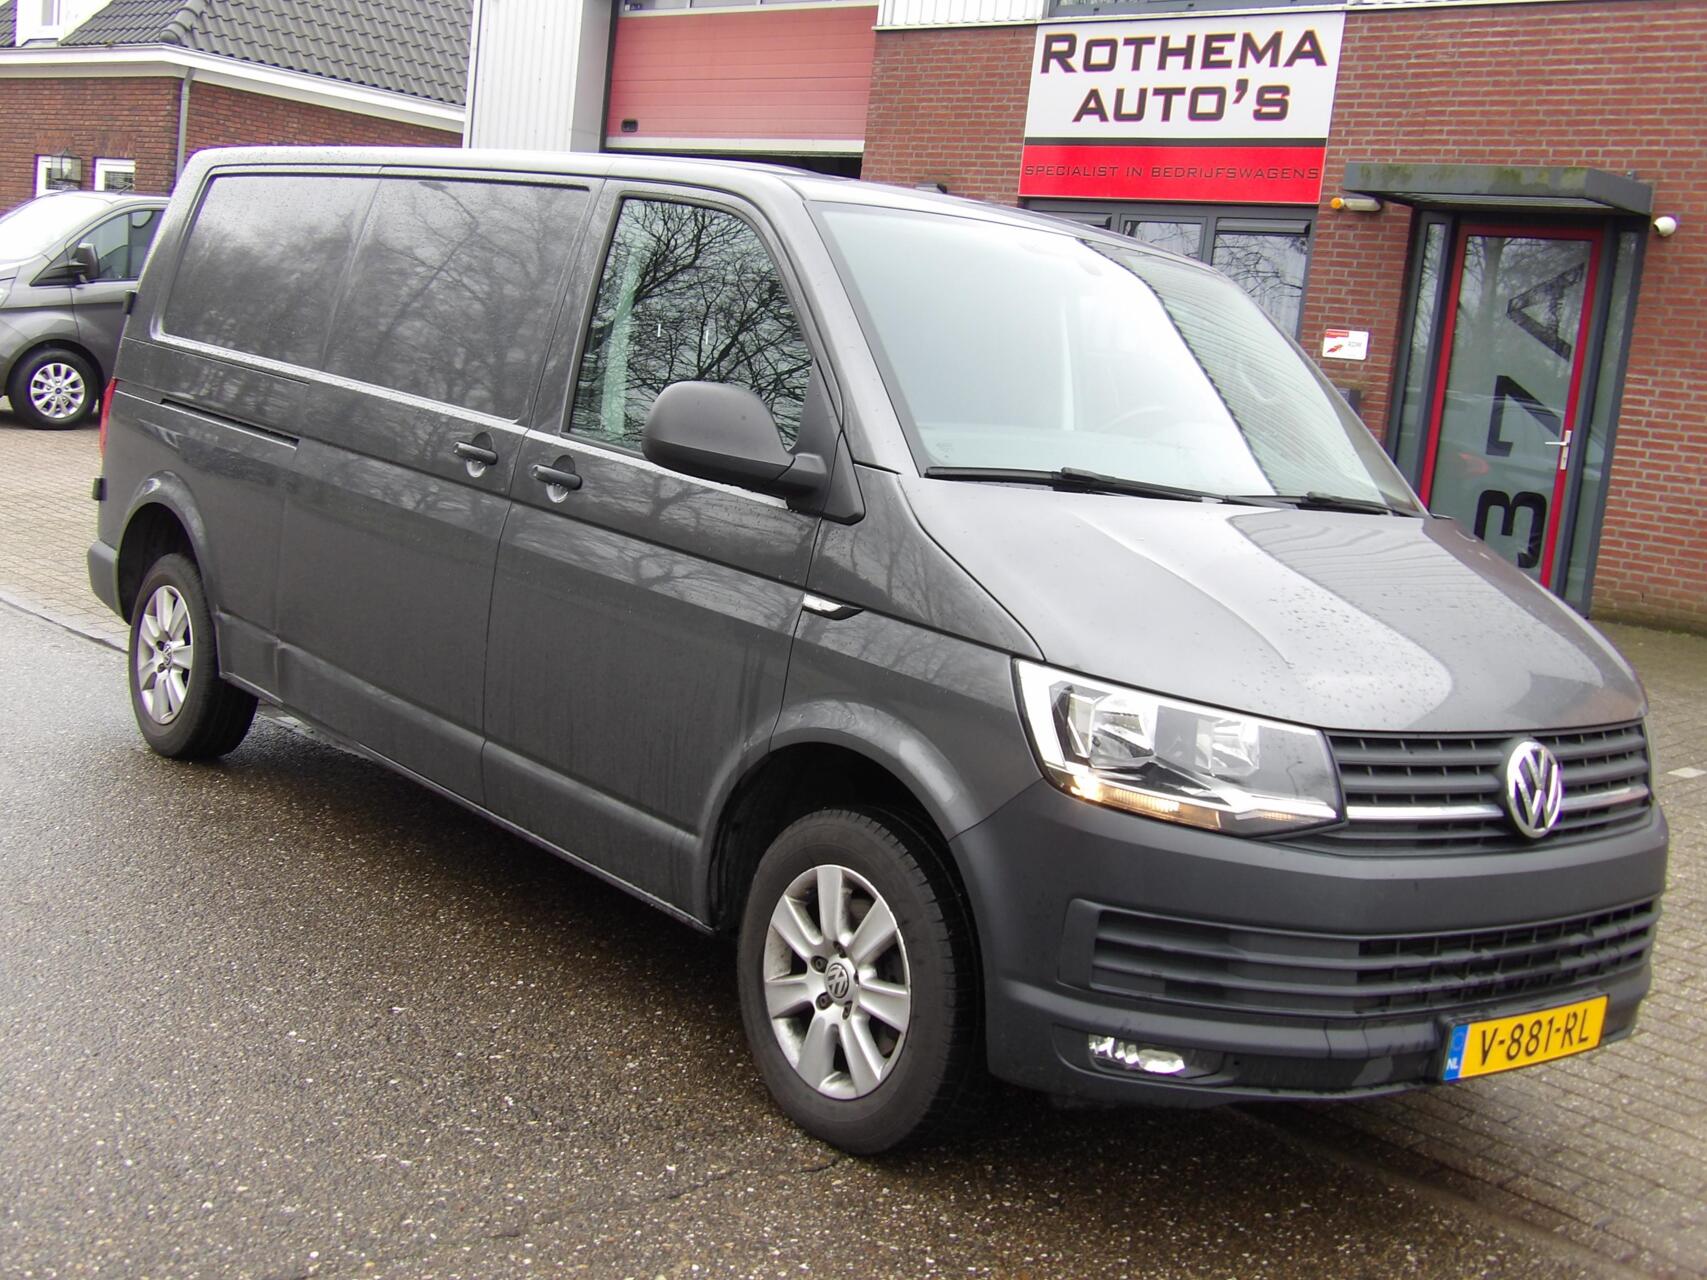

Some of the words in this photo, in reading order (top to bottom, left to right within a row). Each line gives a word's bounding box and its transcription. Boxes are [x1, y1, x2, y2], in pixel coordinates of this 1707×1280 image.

[1040, 30, 1327, 74] ROTHEMA
[1072, 78, 1290, 122] AUTO'S
[1024, 165, 1118, 178] SPECIALIST
[1126, 167, 1143, 177] IN
[1151, 167, 1320, 180] BEDRIJFSWAGENS
[1481, 1009, 1589, 1066] V-881-RL
[1446, 1057, 1459, 1070] NL
